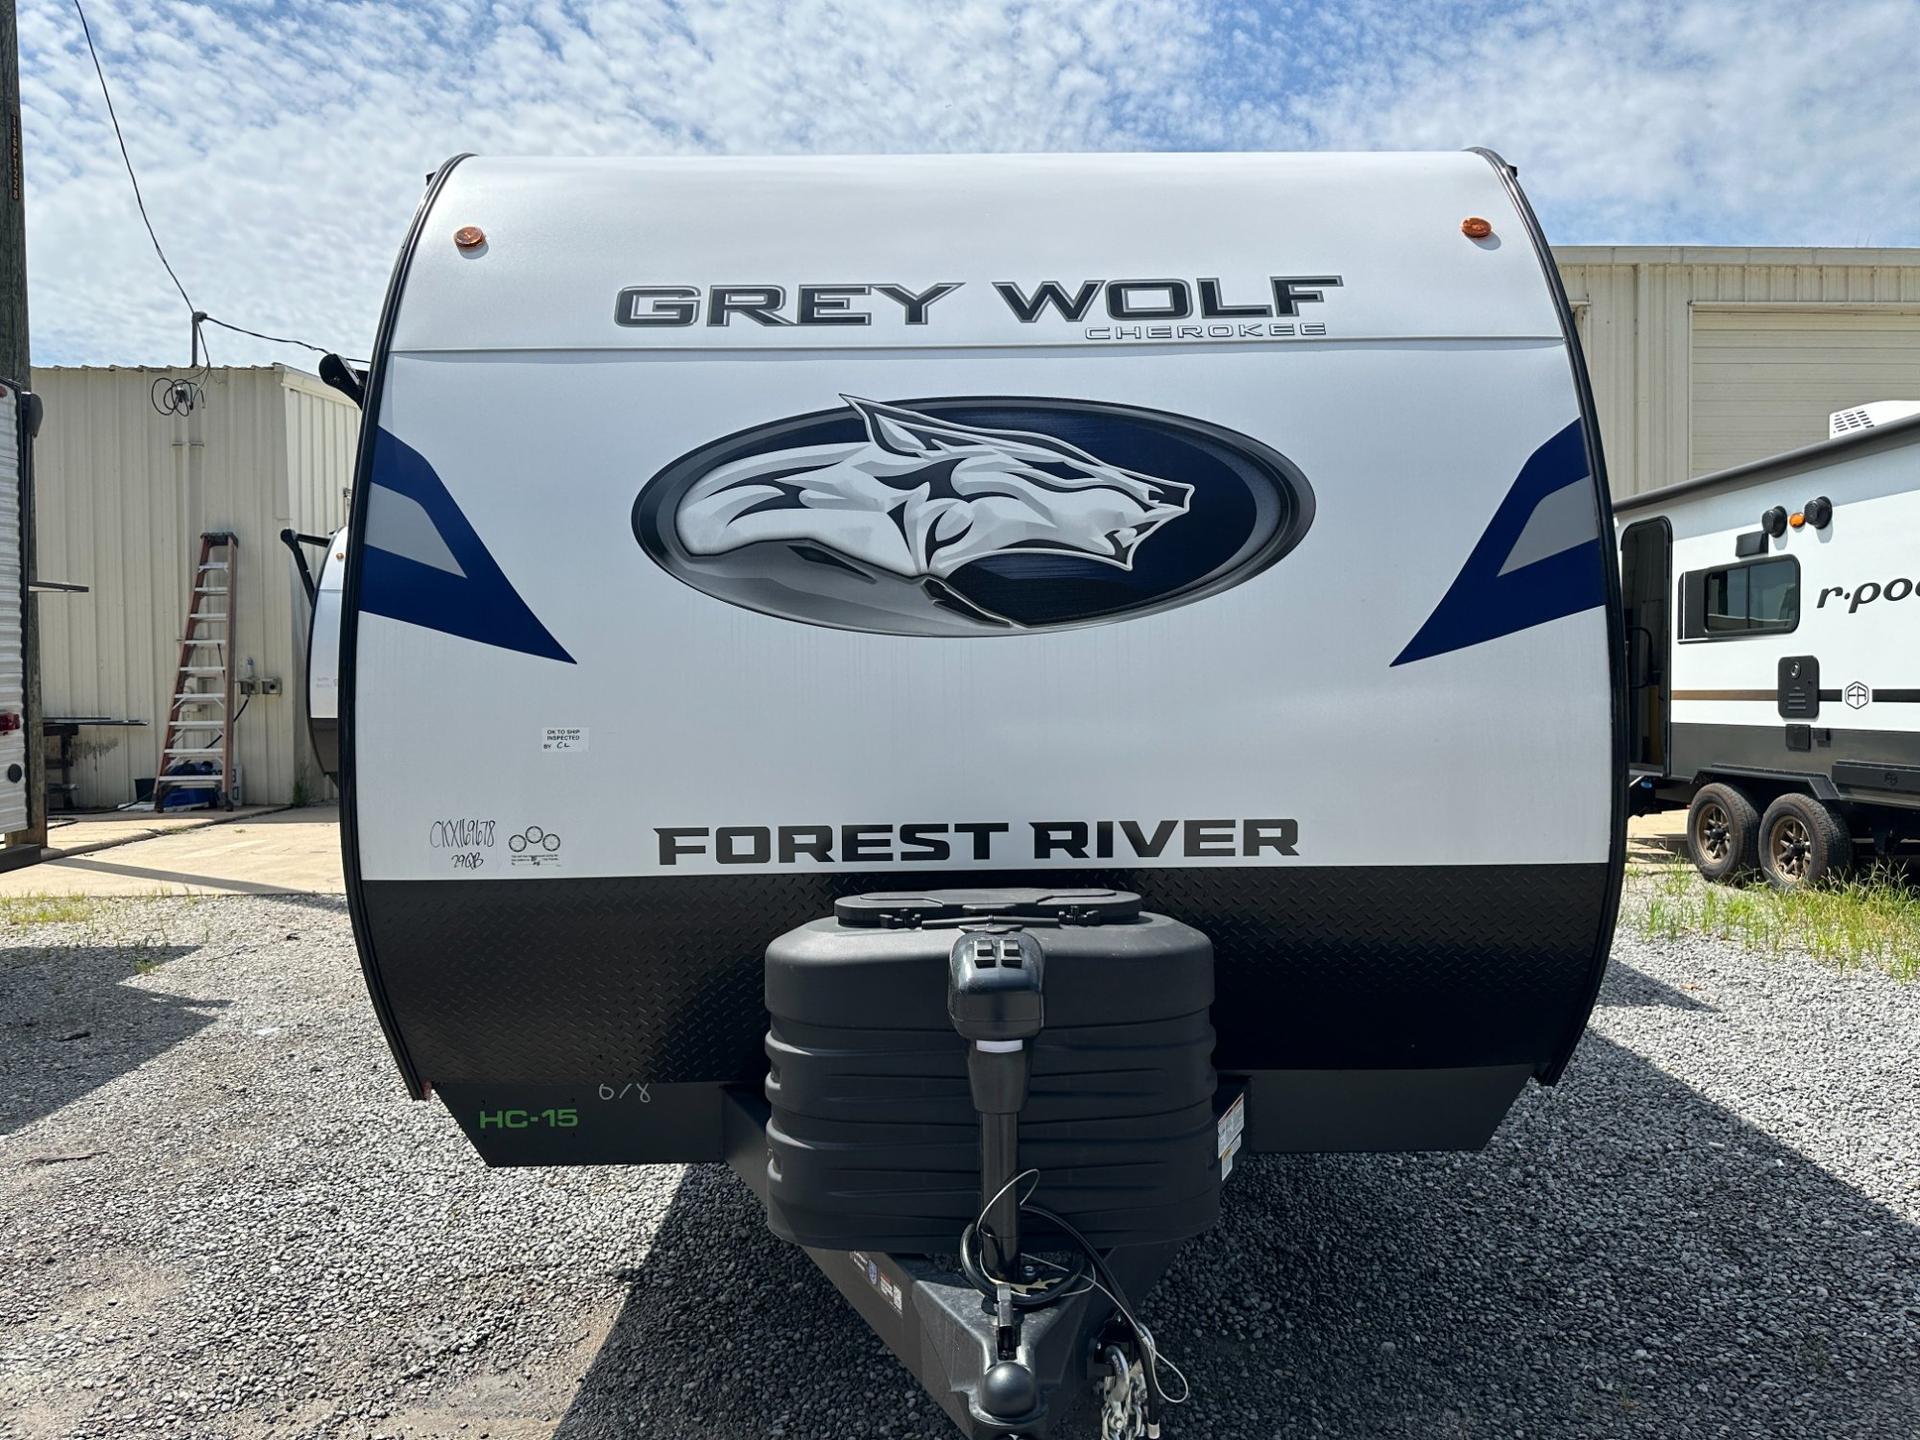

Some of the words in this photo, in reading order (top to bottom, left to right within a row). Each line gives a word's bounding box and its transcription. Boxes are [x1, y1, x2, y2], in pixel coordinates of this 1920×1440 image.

[614, 281, 966, 327] GREY
[991, 275, 1344, 323] WOLF
[1085, 322, 1327, 341] CHEROKEE
[653, 823, 1009, 865] FOREST
[1028, 818, 1300, 859] RIVER
[479, 1108, 579, 1129] HC-15
